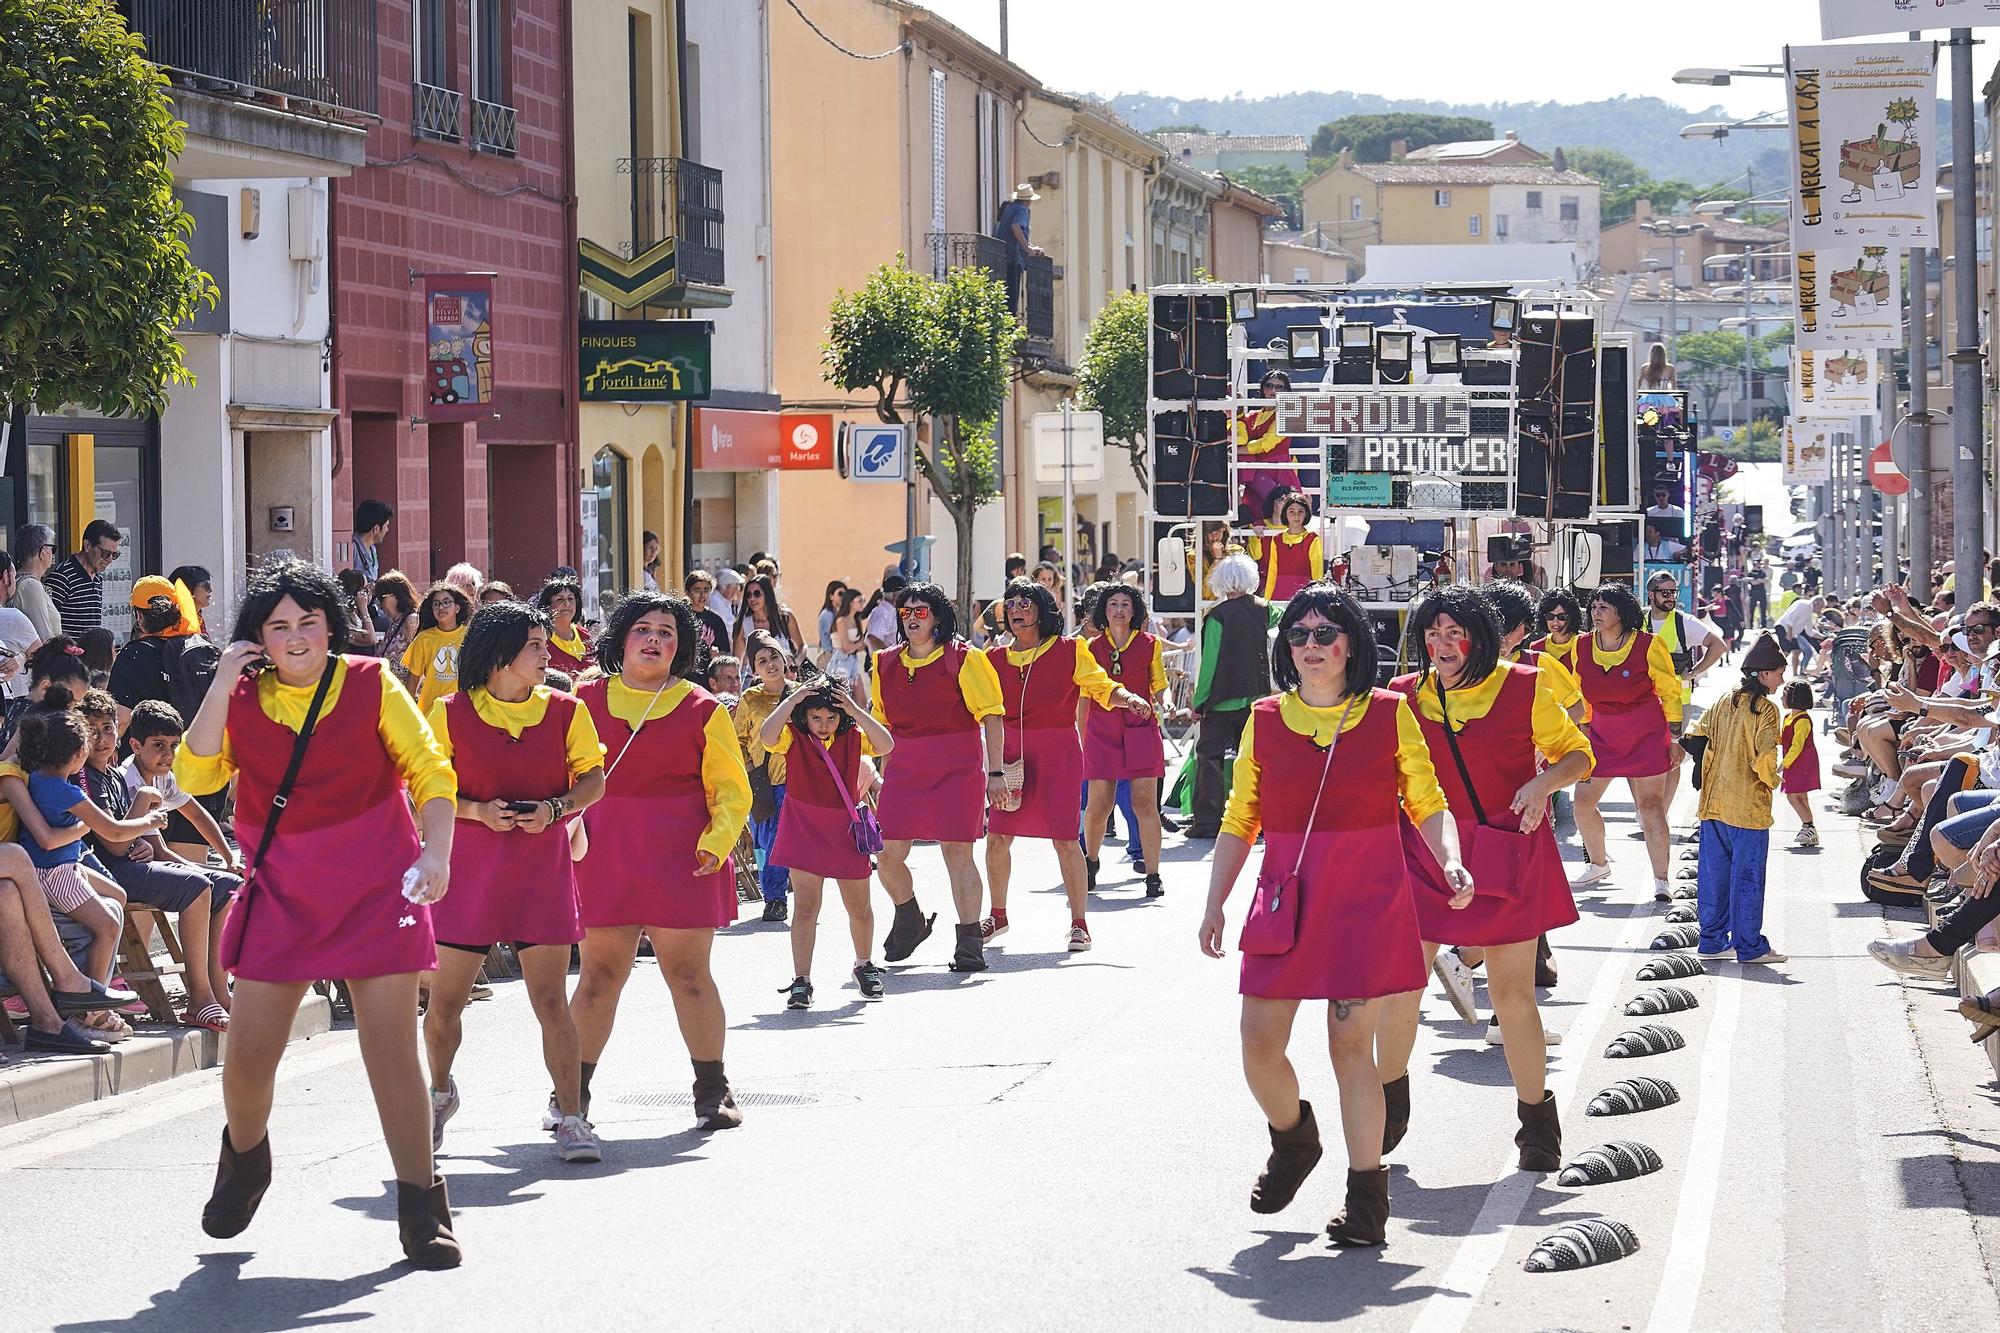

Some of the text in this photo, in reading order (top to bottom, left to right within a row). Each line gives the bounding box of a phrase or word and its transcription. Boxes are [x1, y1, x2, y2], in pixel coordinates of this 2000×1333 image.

[1839, 67, 1890, 77] Palafrugell
[1795, 69, 1826, 226] EL MERCAT A CASA!
[1798, 254, 1820, 333] EL MERCAT A
[582, 337, 636, 348] FINQUES
[601, 374, 668, 390] jordi tané
[1800, 357, 1817, 389] MERCAT
[1802, 391, 1814, 403] EL
[1278, 395, 1468, 432] PERDUTS
[789, 452, 821, 461] Marlex
[1364, 437, 1518, 472] PRIMAVER
